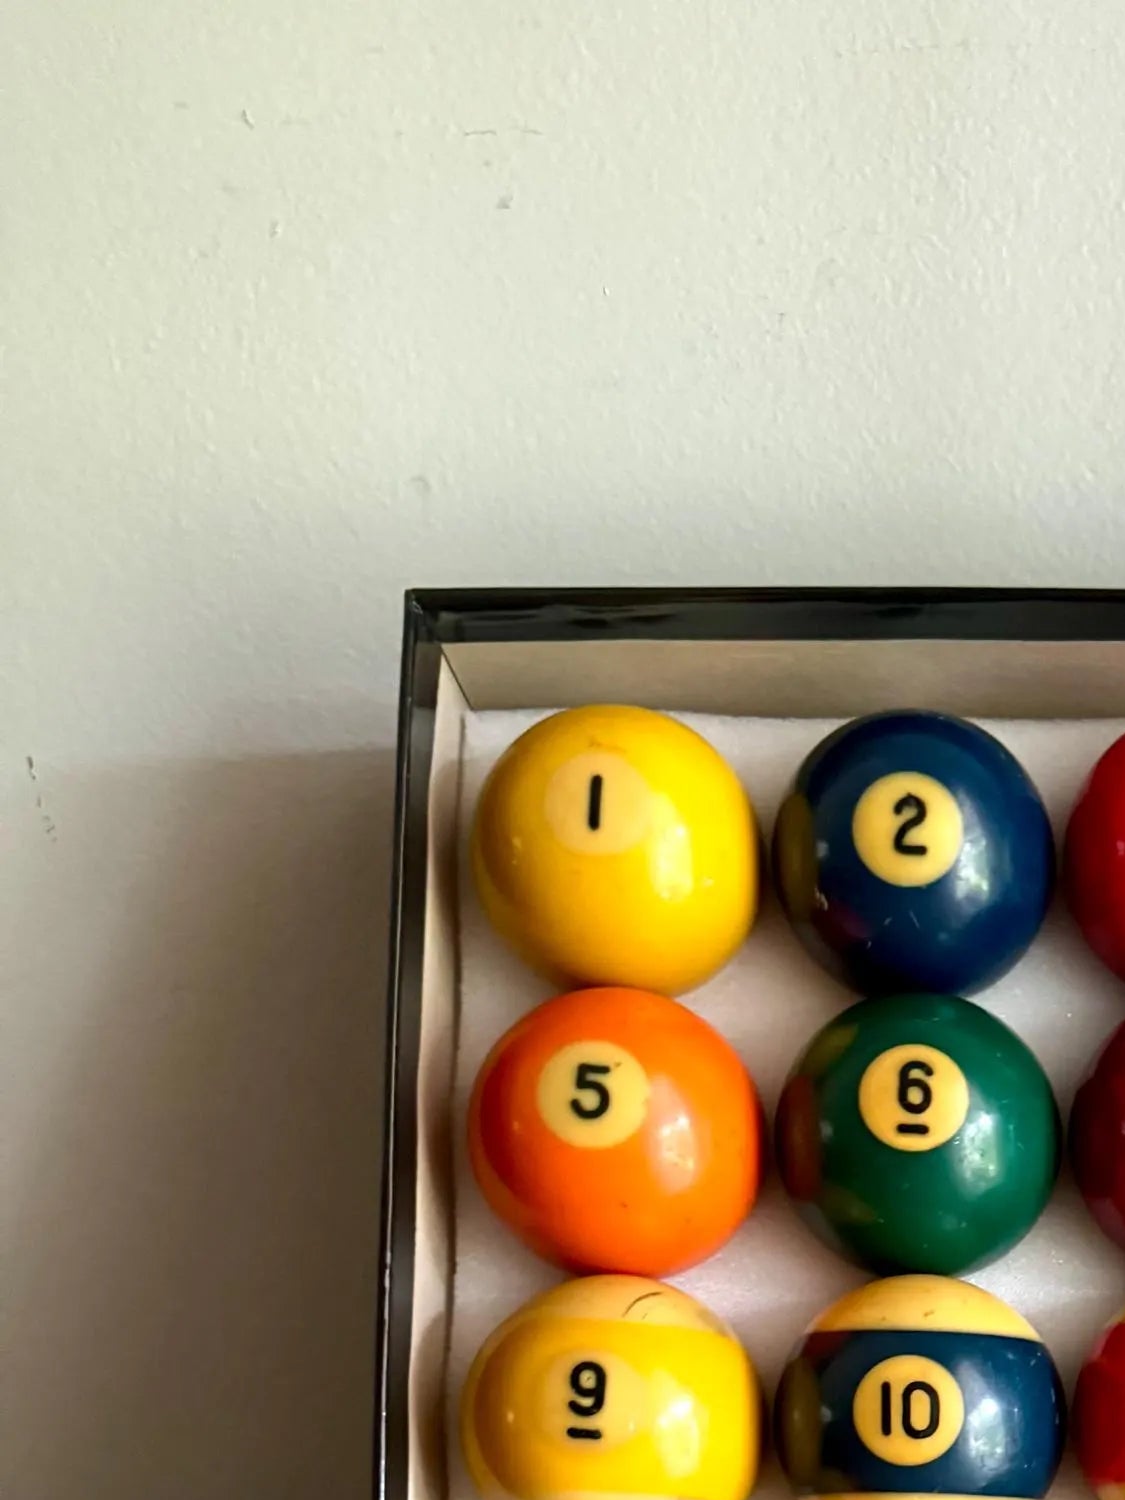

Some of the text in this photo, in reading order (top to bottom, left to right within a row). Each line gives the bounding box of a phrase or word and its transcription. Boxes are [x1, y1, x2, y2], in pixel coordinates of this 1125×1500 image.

[588, 775, 603, 831] 1
[893, 793, 927, 856] 2
[570, 1063, 610, 1120] 5
[897, 1060, 934, 1115] 6
[567, 1361, 606, 1417] 9
[881, 1381, 940, 1439] 10
